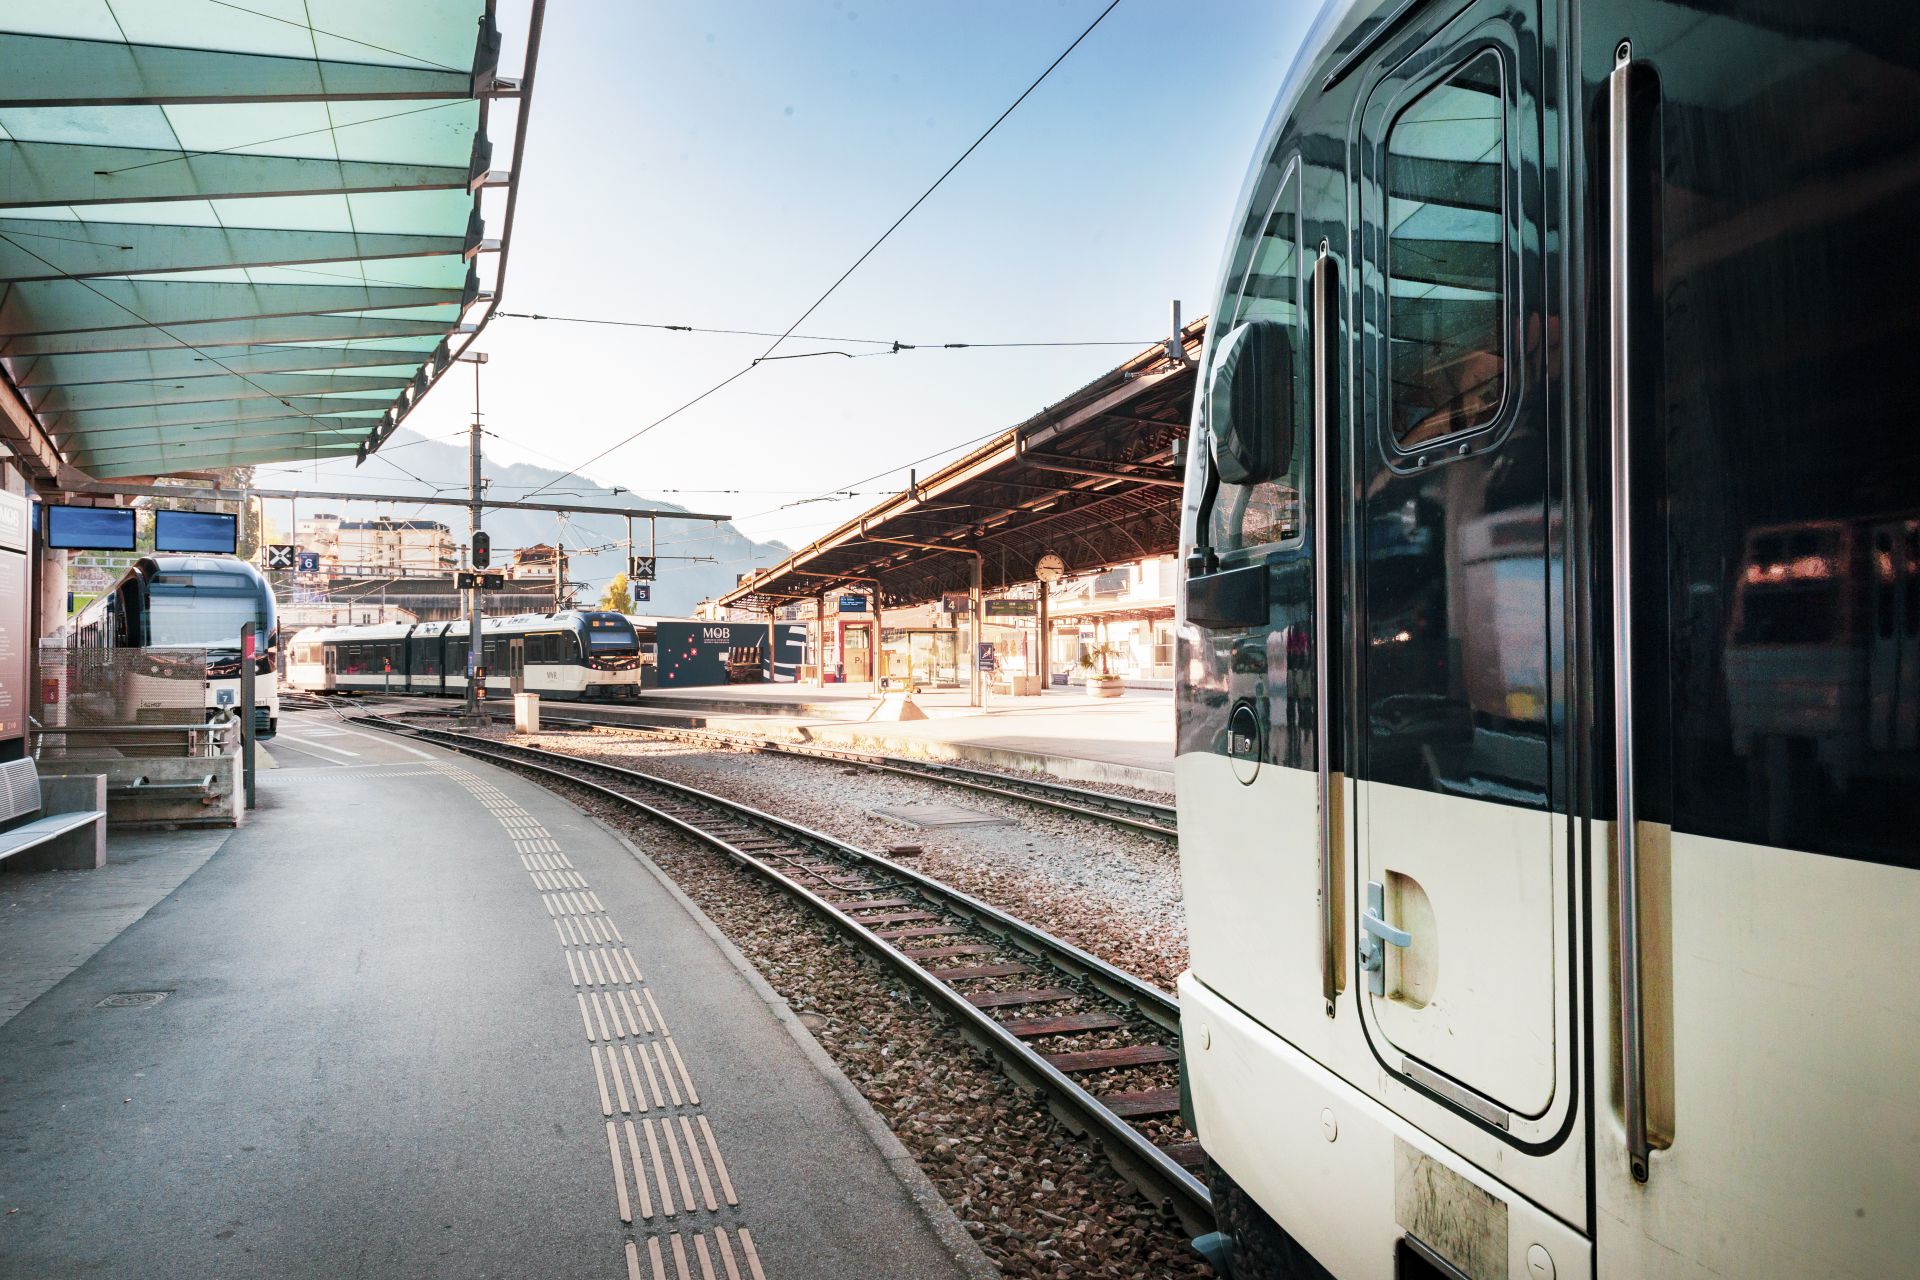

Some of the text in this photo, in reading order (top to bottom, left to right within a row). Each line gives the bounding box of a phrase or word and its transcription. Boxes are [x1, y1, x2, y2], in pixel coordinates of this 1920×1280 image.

[305, 558, 312, 568] 6
[640, 590, 646, 599] 5
[948, 601, 955, 610] 4
[703, 627, 730, 639] MOB
[222, 695, 228, 703] 7
